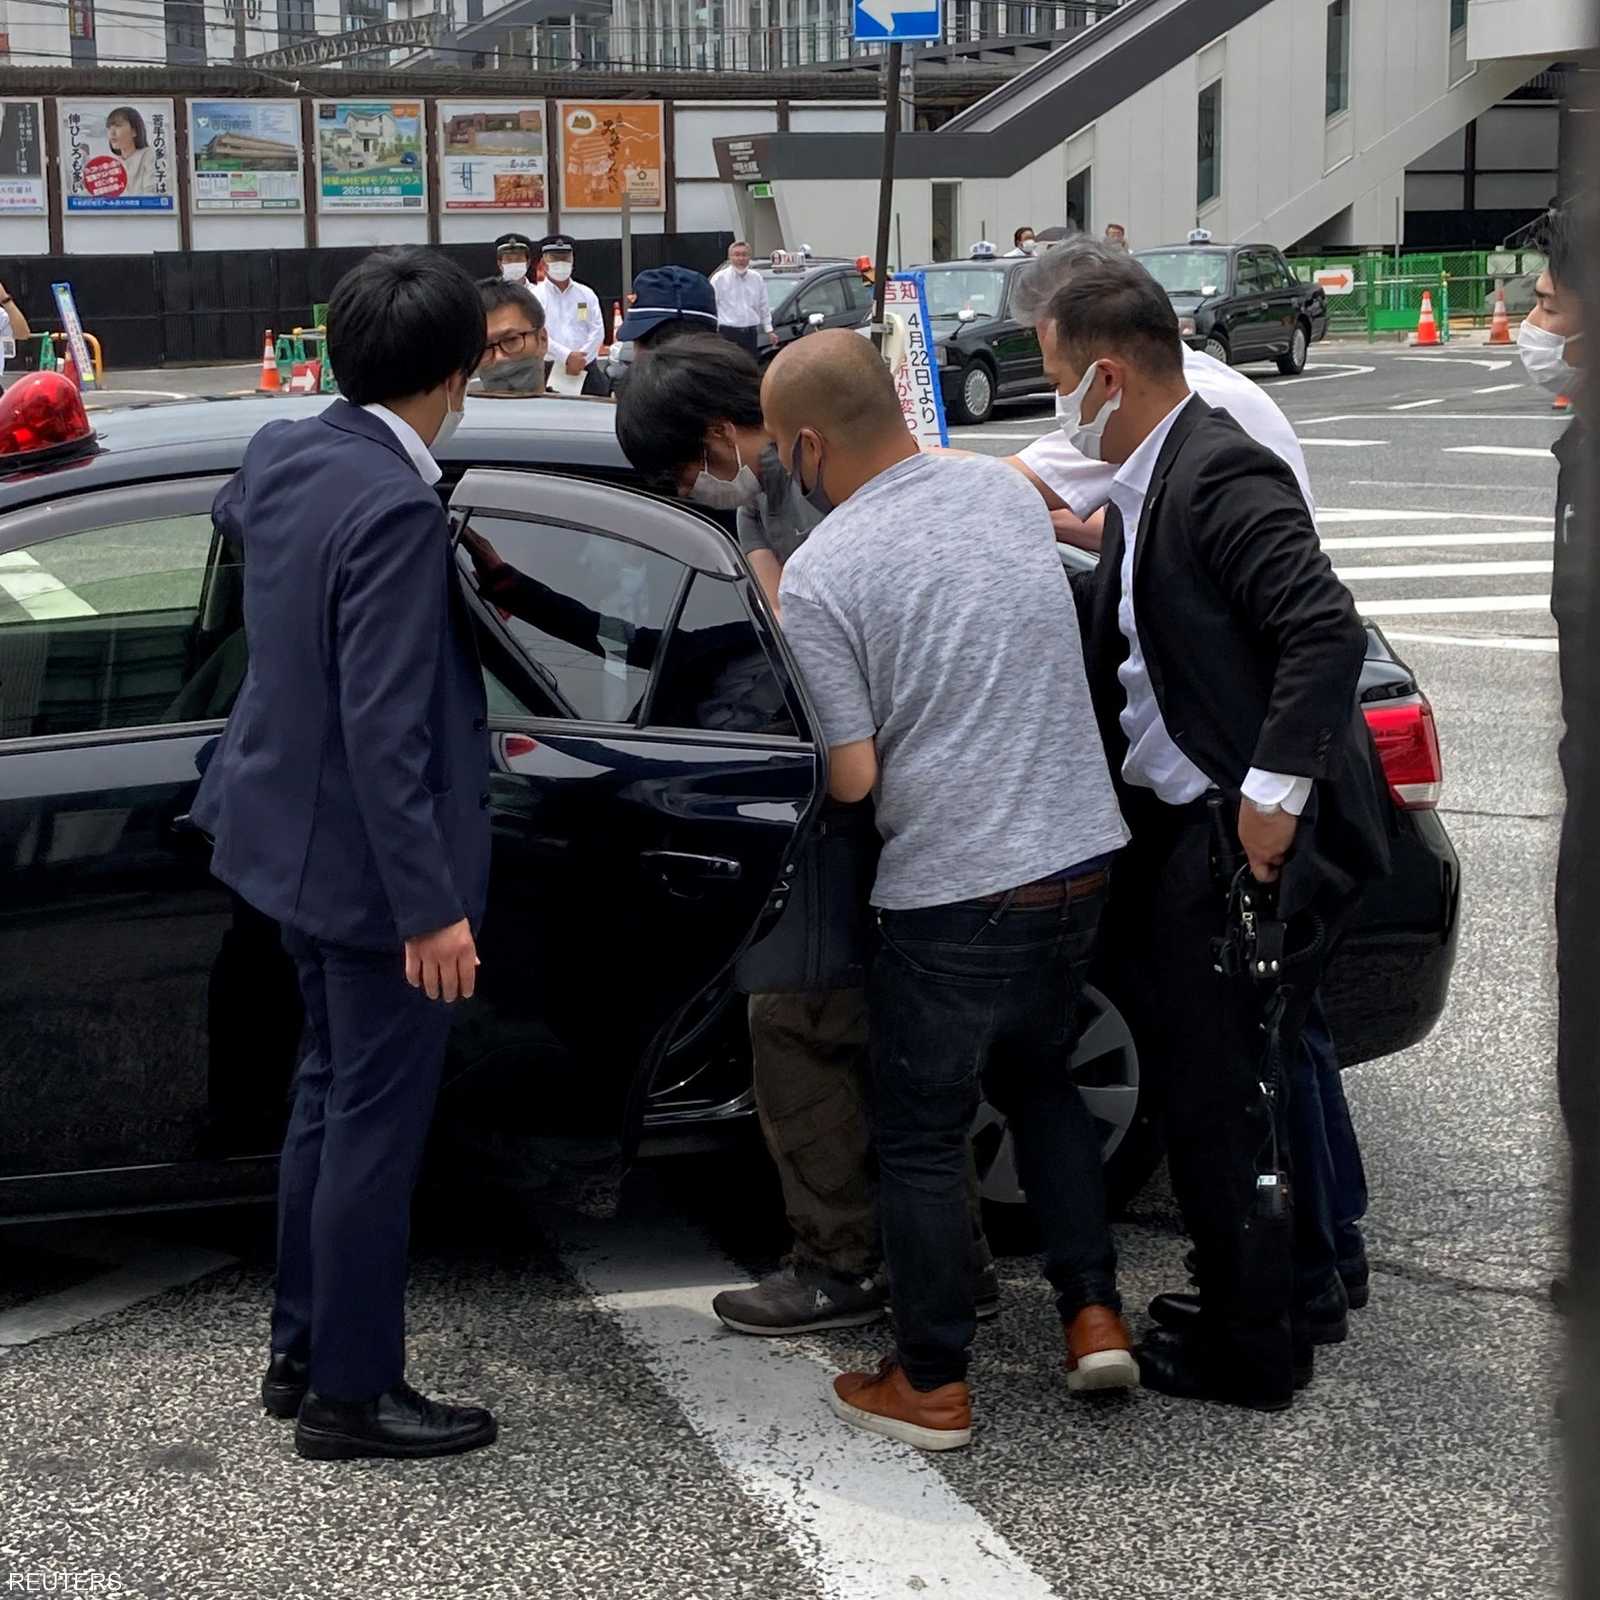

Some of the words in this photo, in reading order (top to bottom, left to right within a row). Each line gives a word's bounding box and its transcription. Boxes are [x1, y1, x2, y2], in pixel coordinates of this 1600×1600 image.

[68, 113, 84, 193] 伸びしろも多い
[152, 114, 167, 193] 苦手の多い子は
[907, 312, 936, 424] 4月22日より
